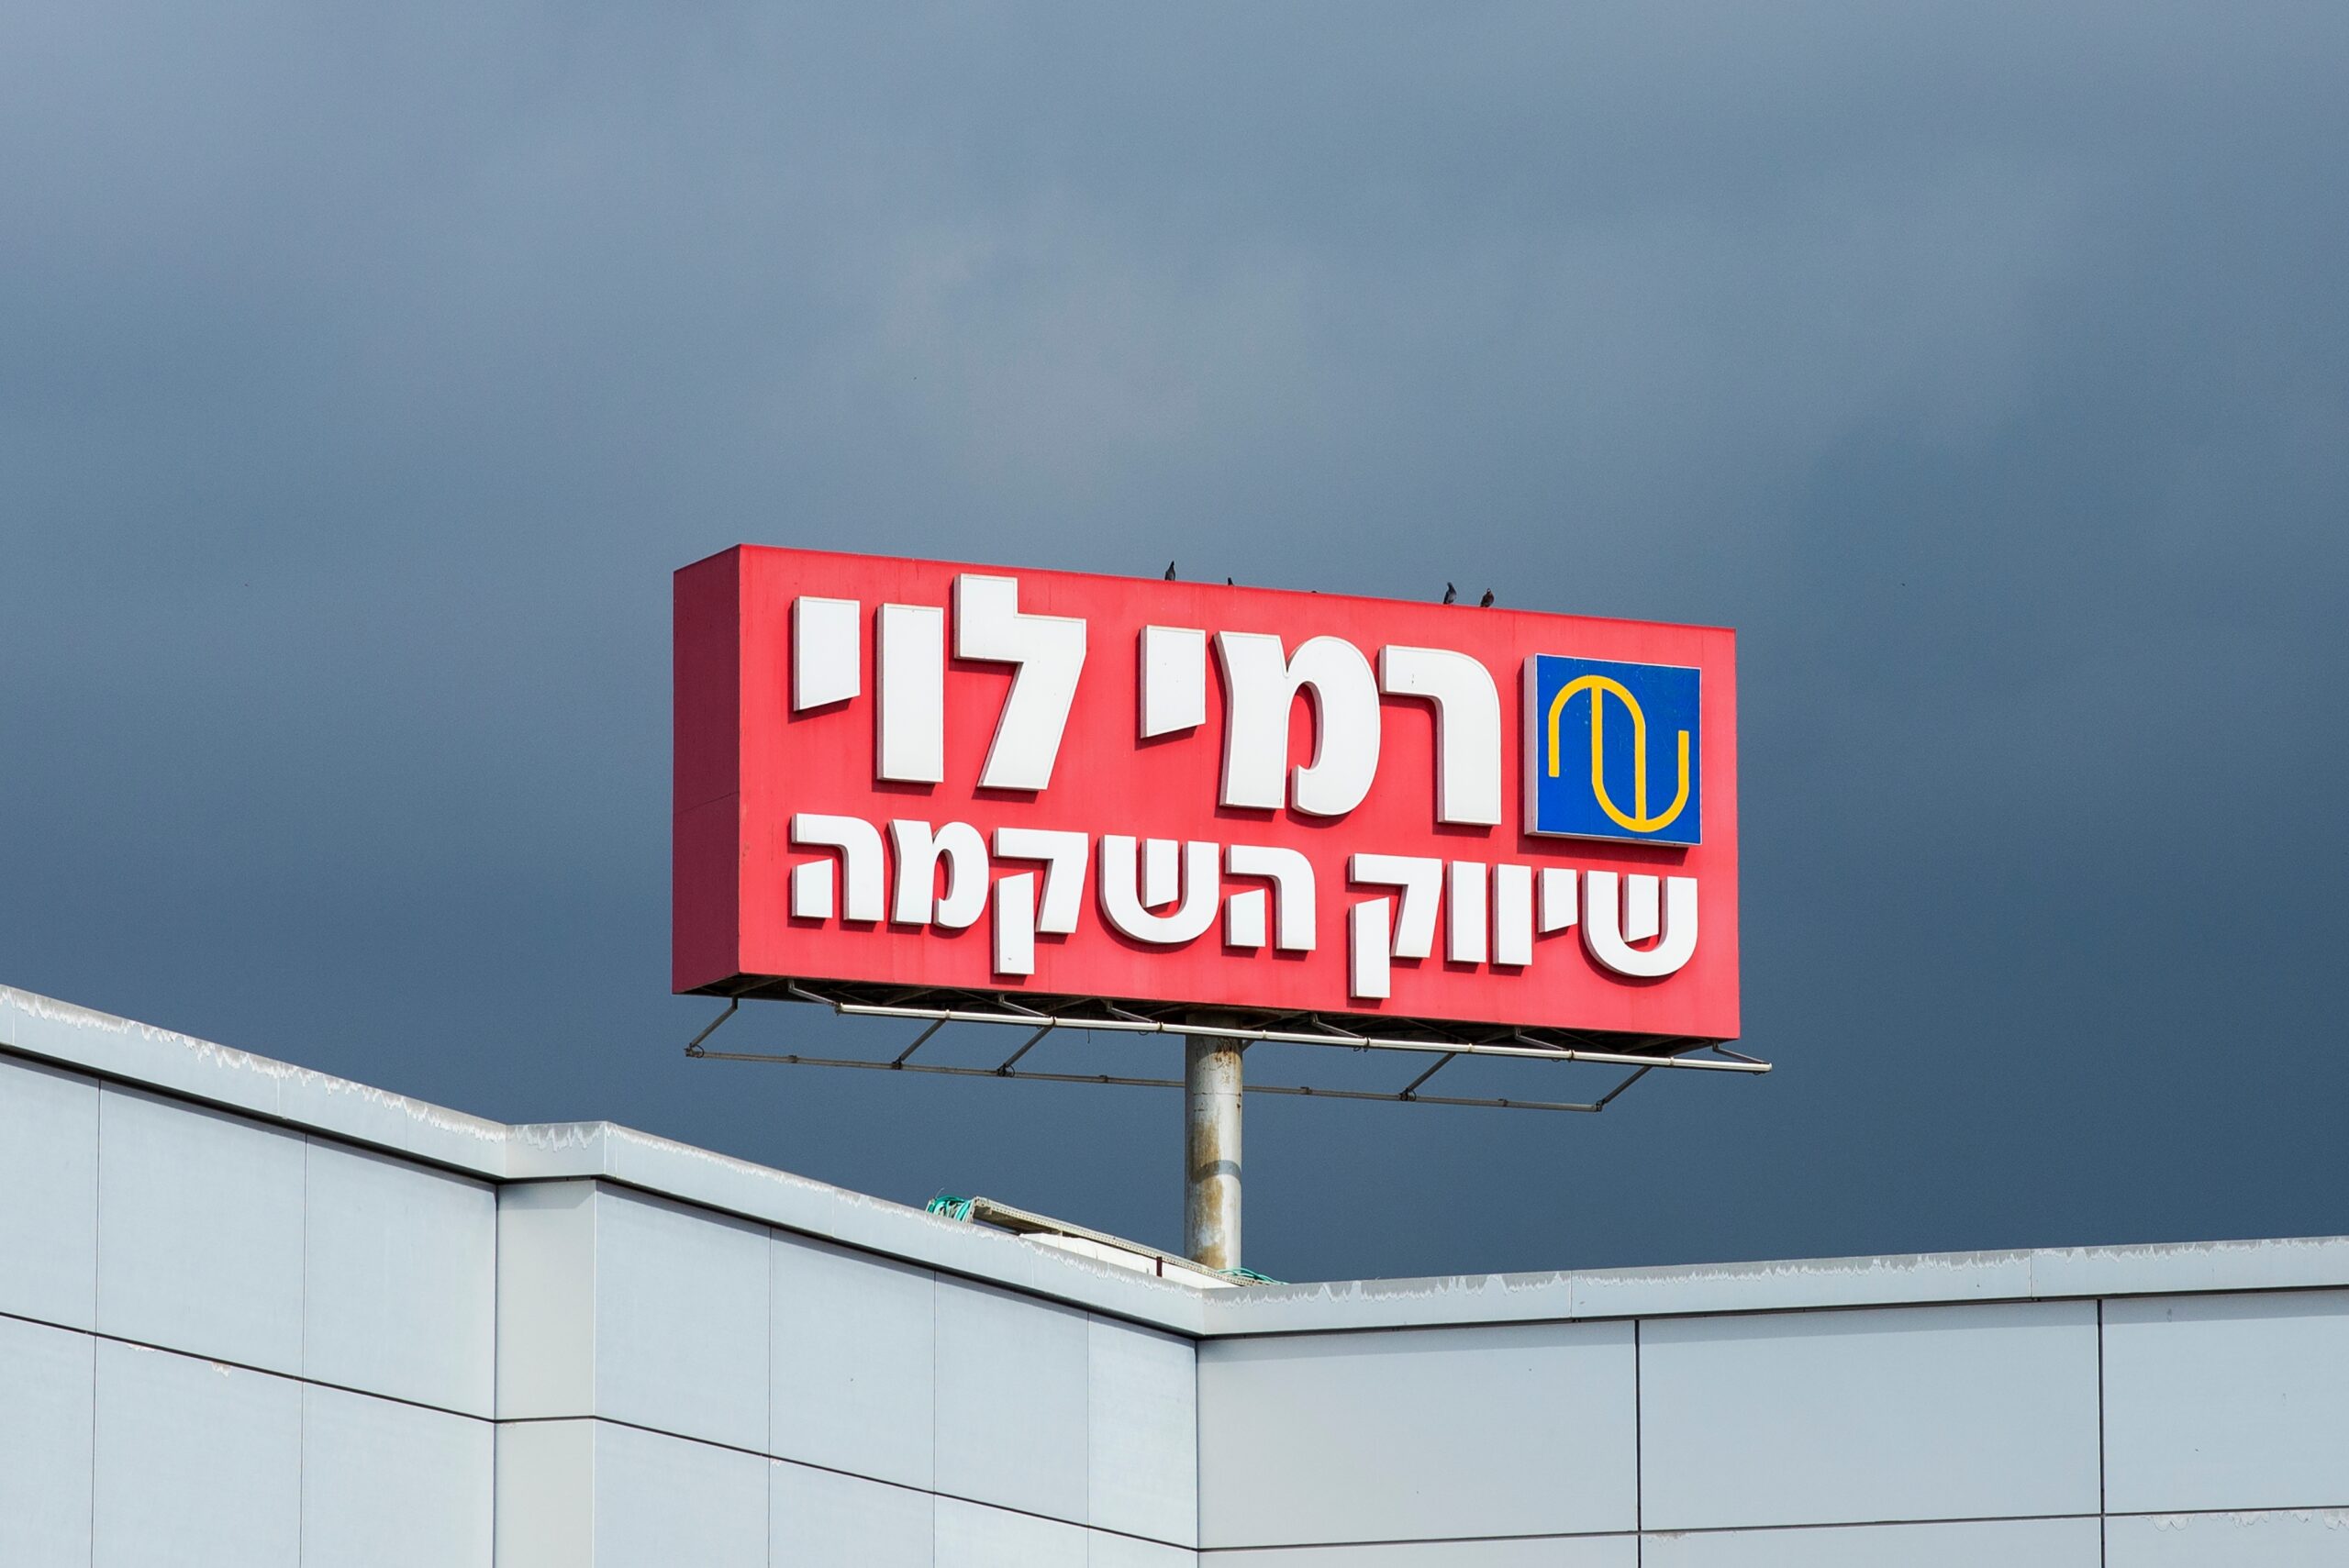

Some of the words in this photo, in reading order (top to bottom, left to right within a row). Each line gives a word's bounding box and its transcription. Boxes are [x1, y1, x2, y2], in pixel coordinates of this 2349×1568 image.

[793, 573, 1087, 790] לוי
[1140, 626, 1502, 825] רמי
[790, 813, 1317, 975] השקמה
[1350, 853, 1698, 1000] שיווק
